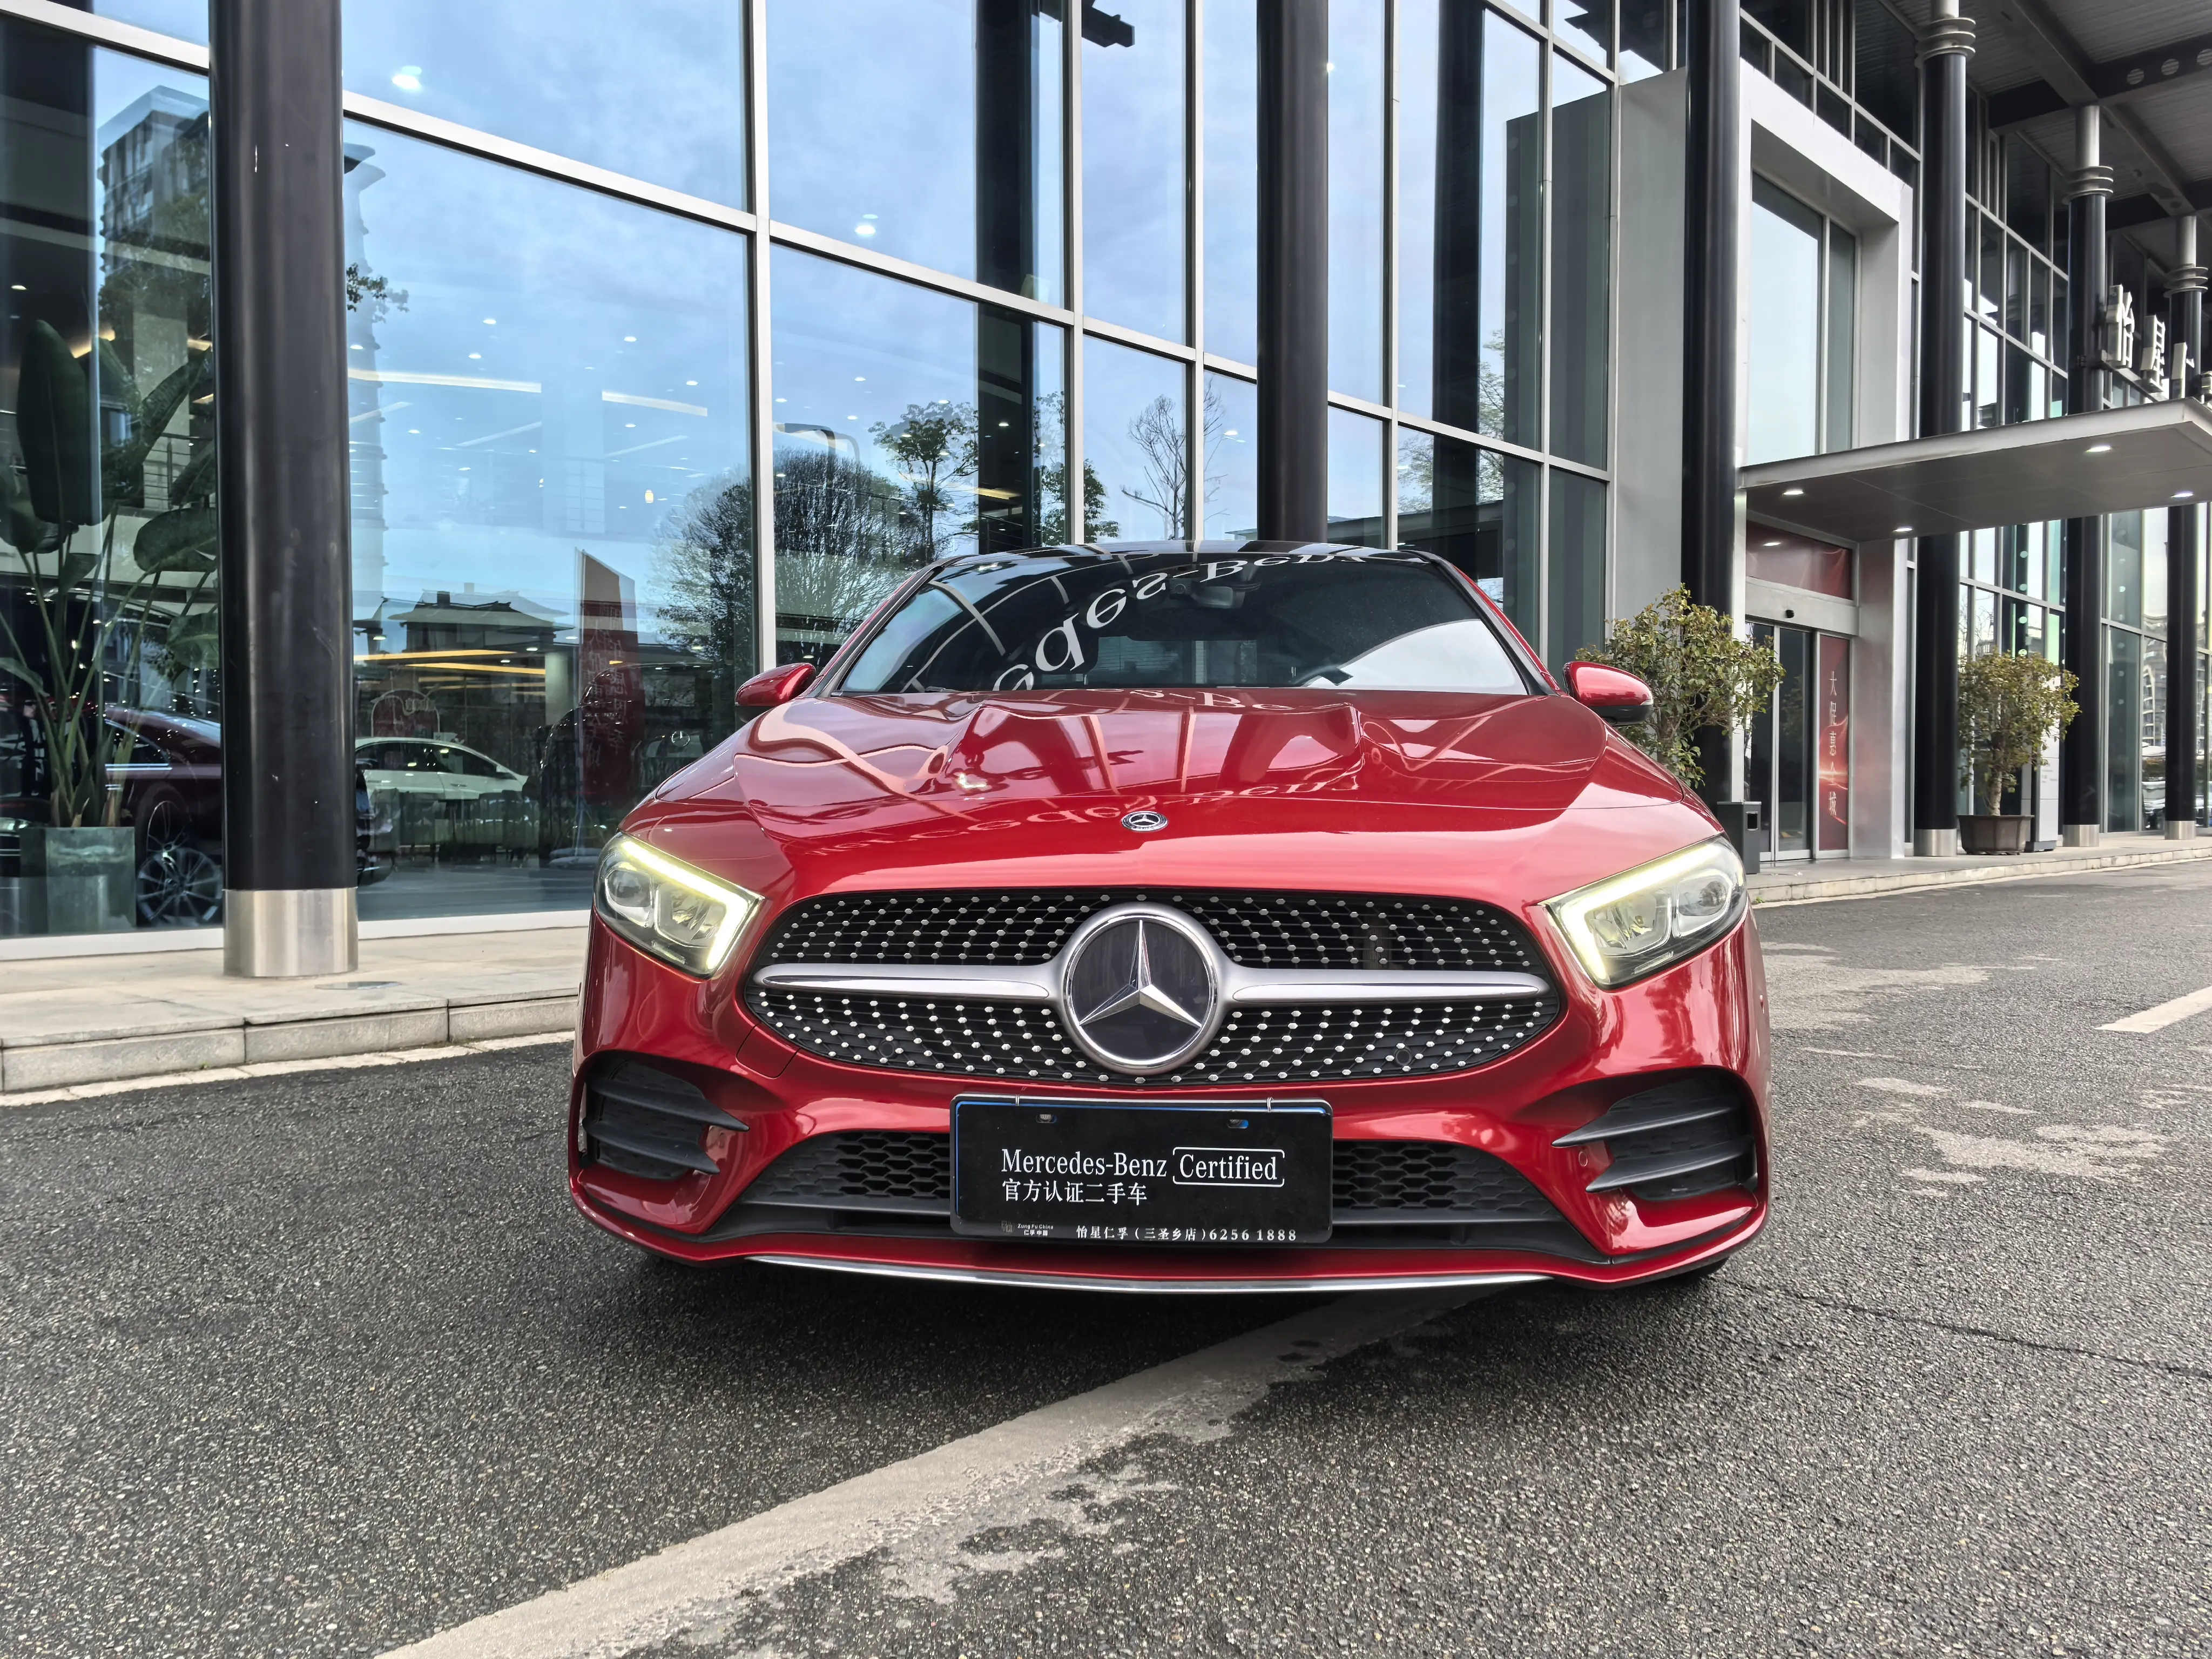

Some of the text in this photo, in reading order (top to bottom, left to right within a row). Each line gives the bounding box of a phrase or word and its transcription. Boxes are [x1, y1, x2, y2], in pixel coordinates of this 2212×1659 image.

[1001, 1149, 1278, 1180] Mercedes-Benz Certified
[1002, 1178, 1147, 1206] 官方认证二手车
